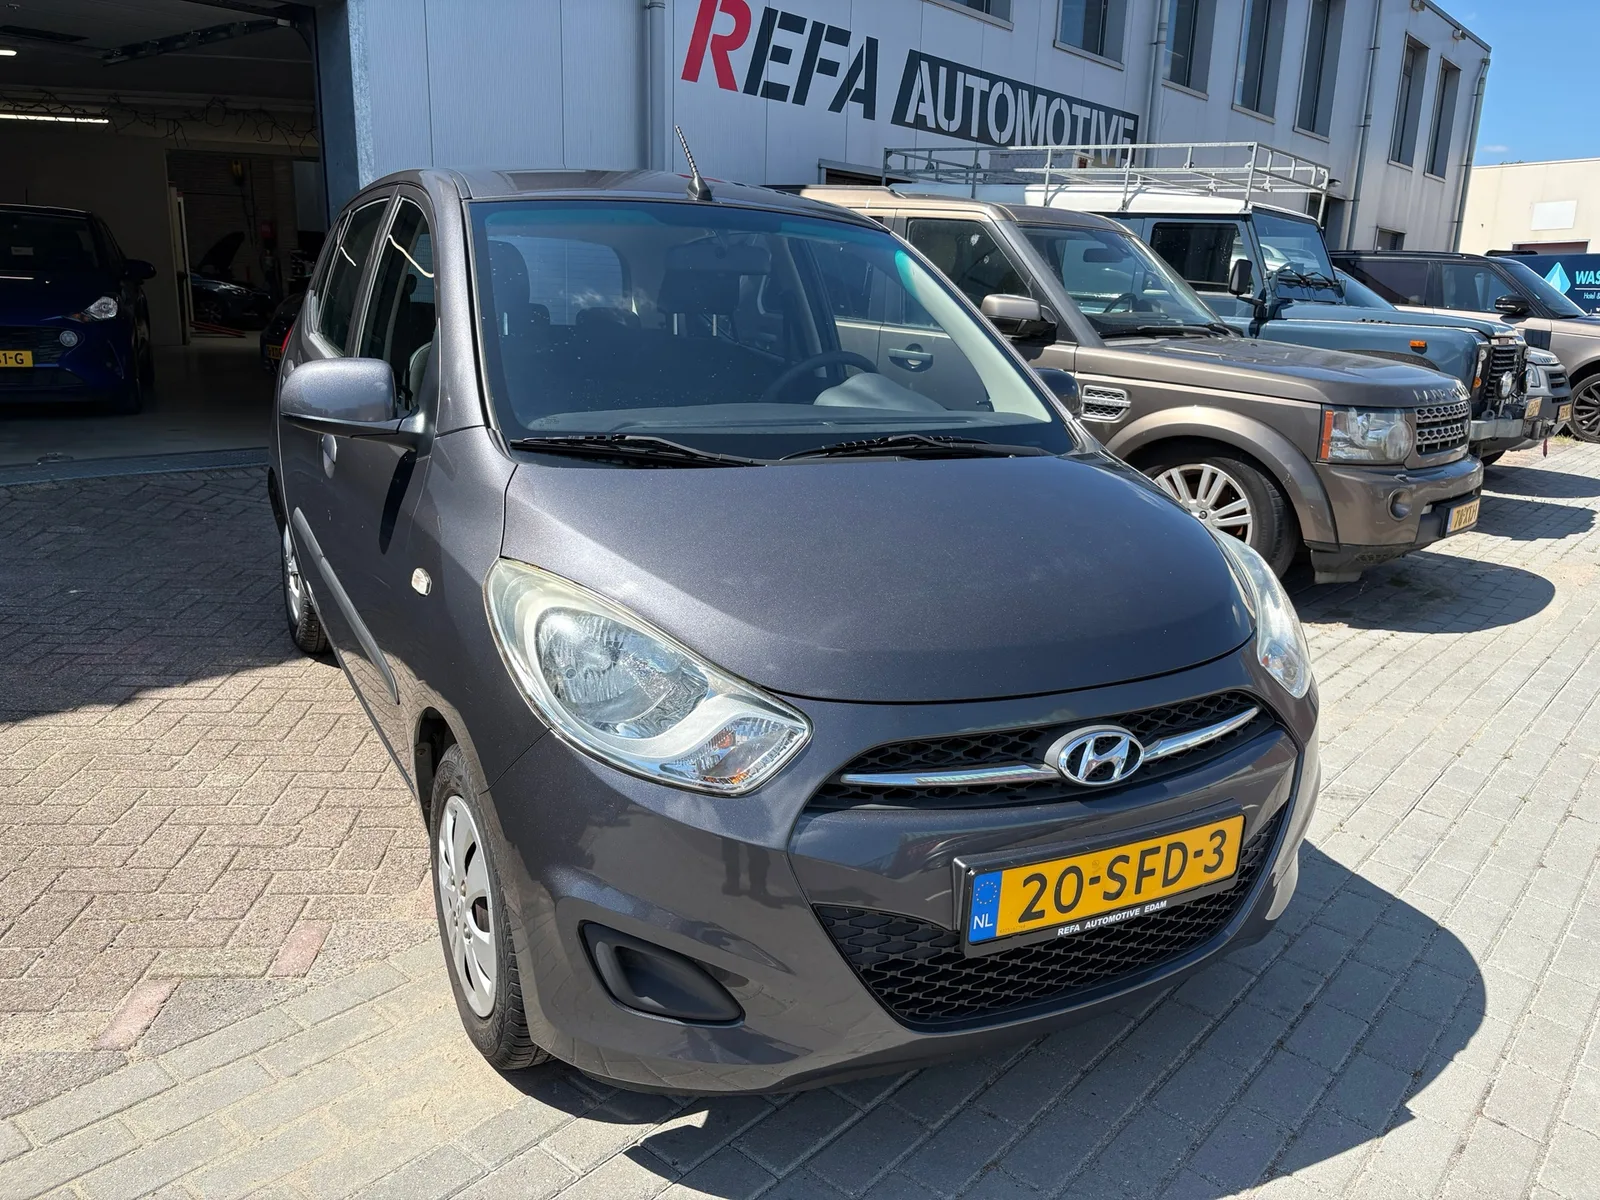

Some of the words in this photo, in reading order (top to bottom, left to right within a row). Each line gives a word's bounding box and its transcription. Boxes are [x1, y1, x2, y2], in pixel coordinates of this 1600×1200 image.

[681, 0, 878, 121] REFA
[905, 60, 1136, 166] AUTOMOTIVE
[0, 352, 24, 365] 1-G
[1017, 829, 1228, 924] 20-SFD-3
[973, 914, 993, 930] NL
[1057, 924, 1080, 936] REFA
[1084, 907, 1141, 929] AUTOMOTIVE
[1144, 900, 1167, 913] EDAM
